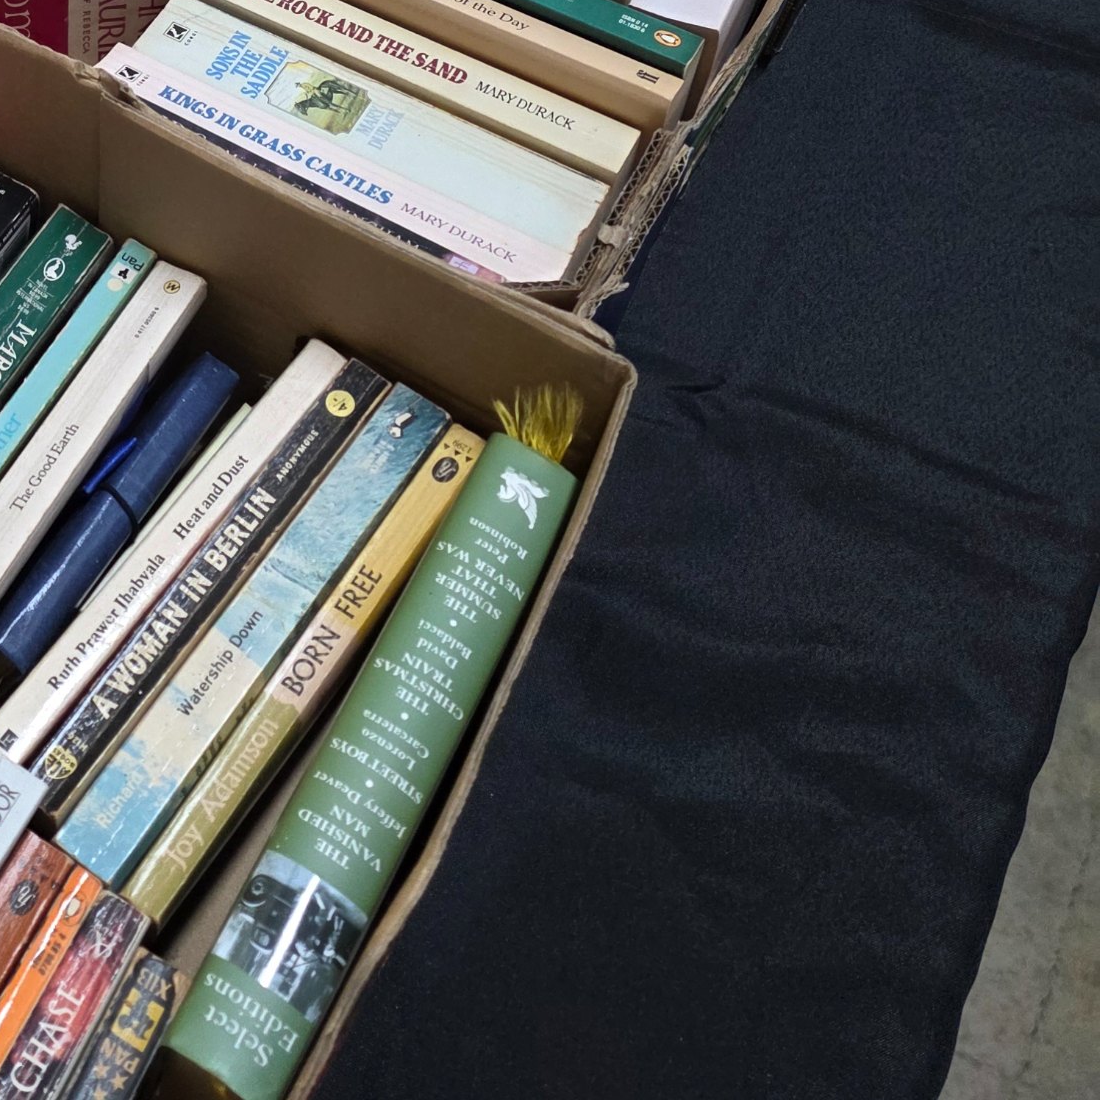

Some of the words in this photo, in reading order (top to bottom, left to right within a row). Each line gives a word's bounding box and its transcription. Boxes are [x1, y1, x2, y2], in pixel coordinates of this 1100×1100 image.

[331, 14, 375, 45] AND
[371, 32, 413, 62] THE
[412, 52, 468, 84] SAND
[475, 81, 517, 104] MARY
[516, 98, 574, 130] DURACK
[472, 0, 497, 17] the
[499, 12, 530, 32] Day
[160, 85, 217, 119] KINGS
[215, 110, 240, 133] IN
[239, 124, 305, 161] GRASS
[305, 156, 392, 204] CASTLES
[401, 203, 448, 229] MARY
[448, 225, 516, 263] DURACK
[274, 429, 320, 482] ANONYMOUS
[47, 655, 80, 690] Ruth
[75, 608, 119, 655] Prawer
[114, 554, 165, 609] Jhabvala
[173, 506, 205, 540] Heat
[200, 482, 224, 509] and
[218, 455, 248, 486] Dust
[88, 690, 119, 720] A
[107, 600, 189, 698] WOMAN
[178, 567, 213, 603] IN
[206, 484, 277, 572] BERLIN
[282, 625, 340, 695] BORN
[335, 564, 382, 619] FREE
[10, 981, 87, 1093] CHASE
[204, 1004, 274, 1068] Select
[205, 971, 299, 1054] Editions
